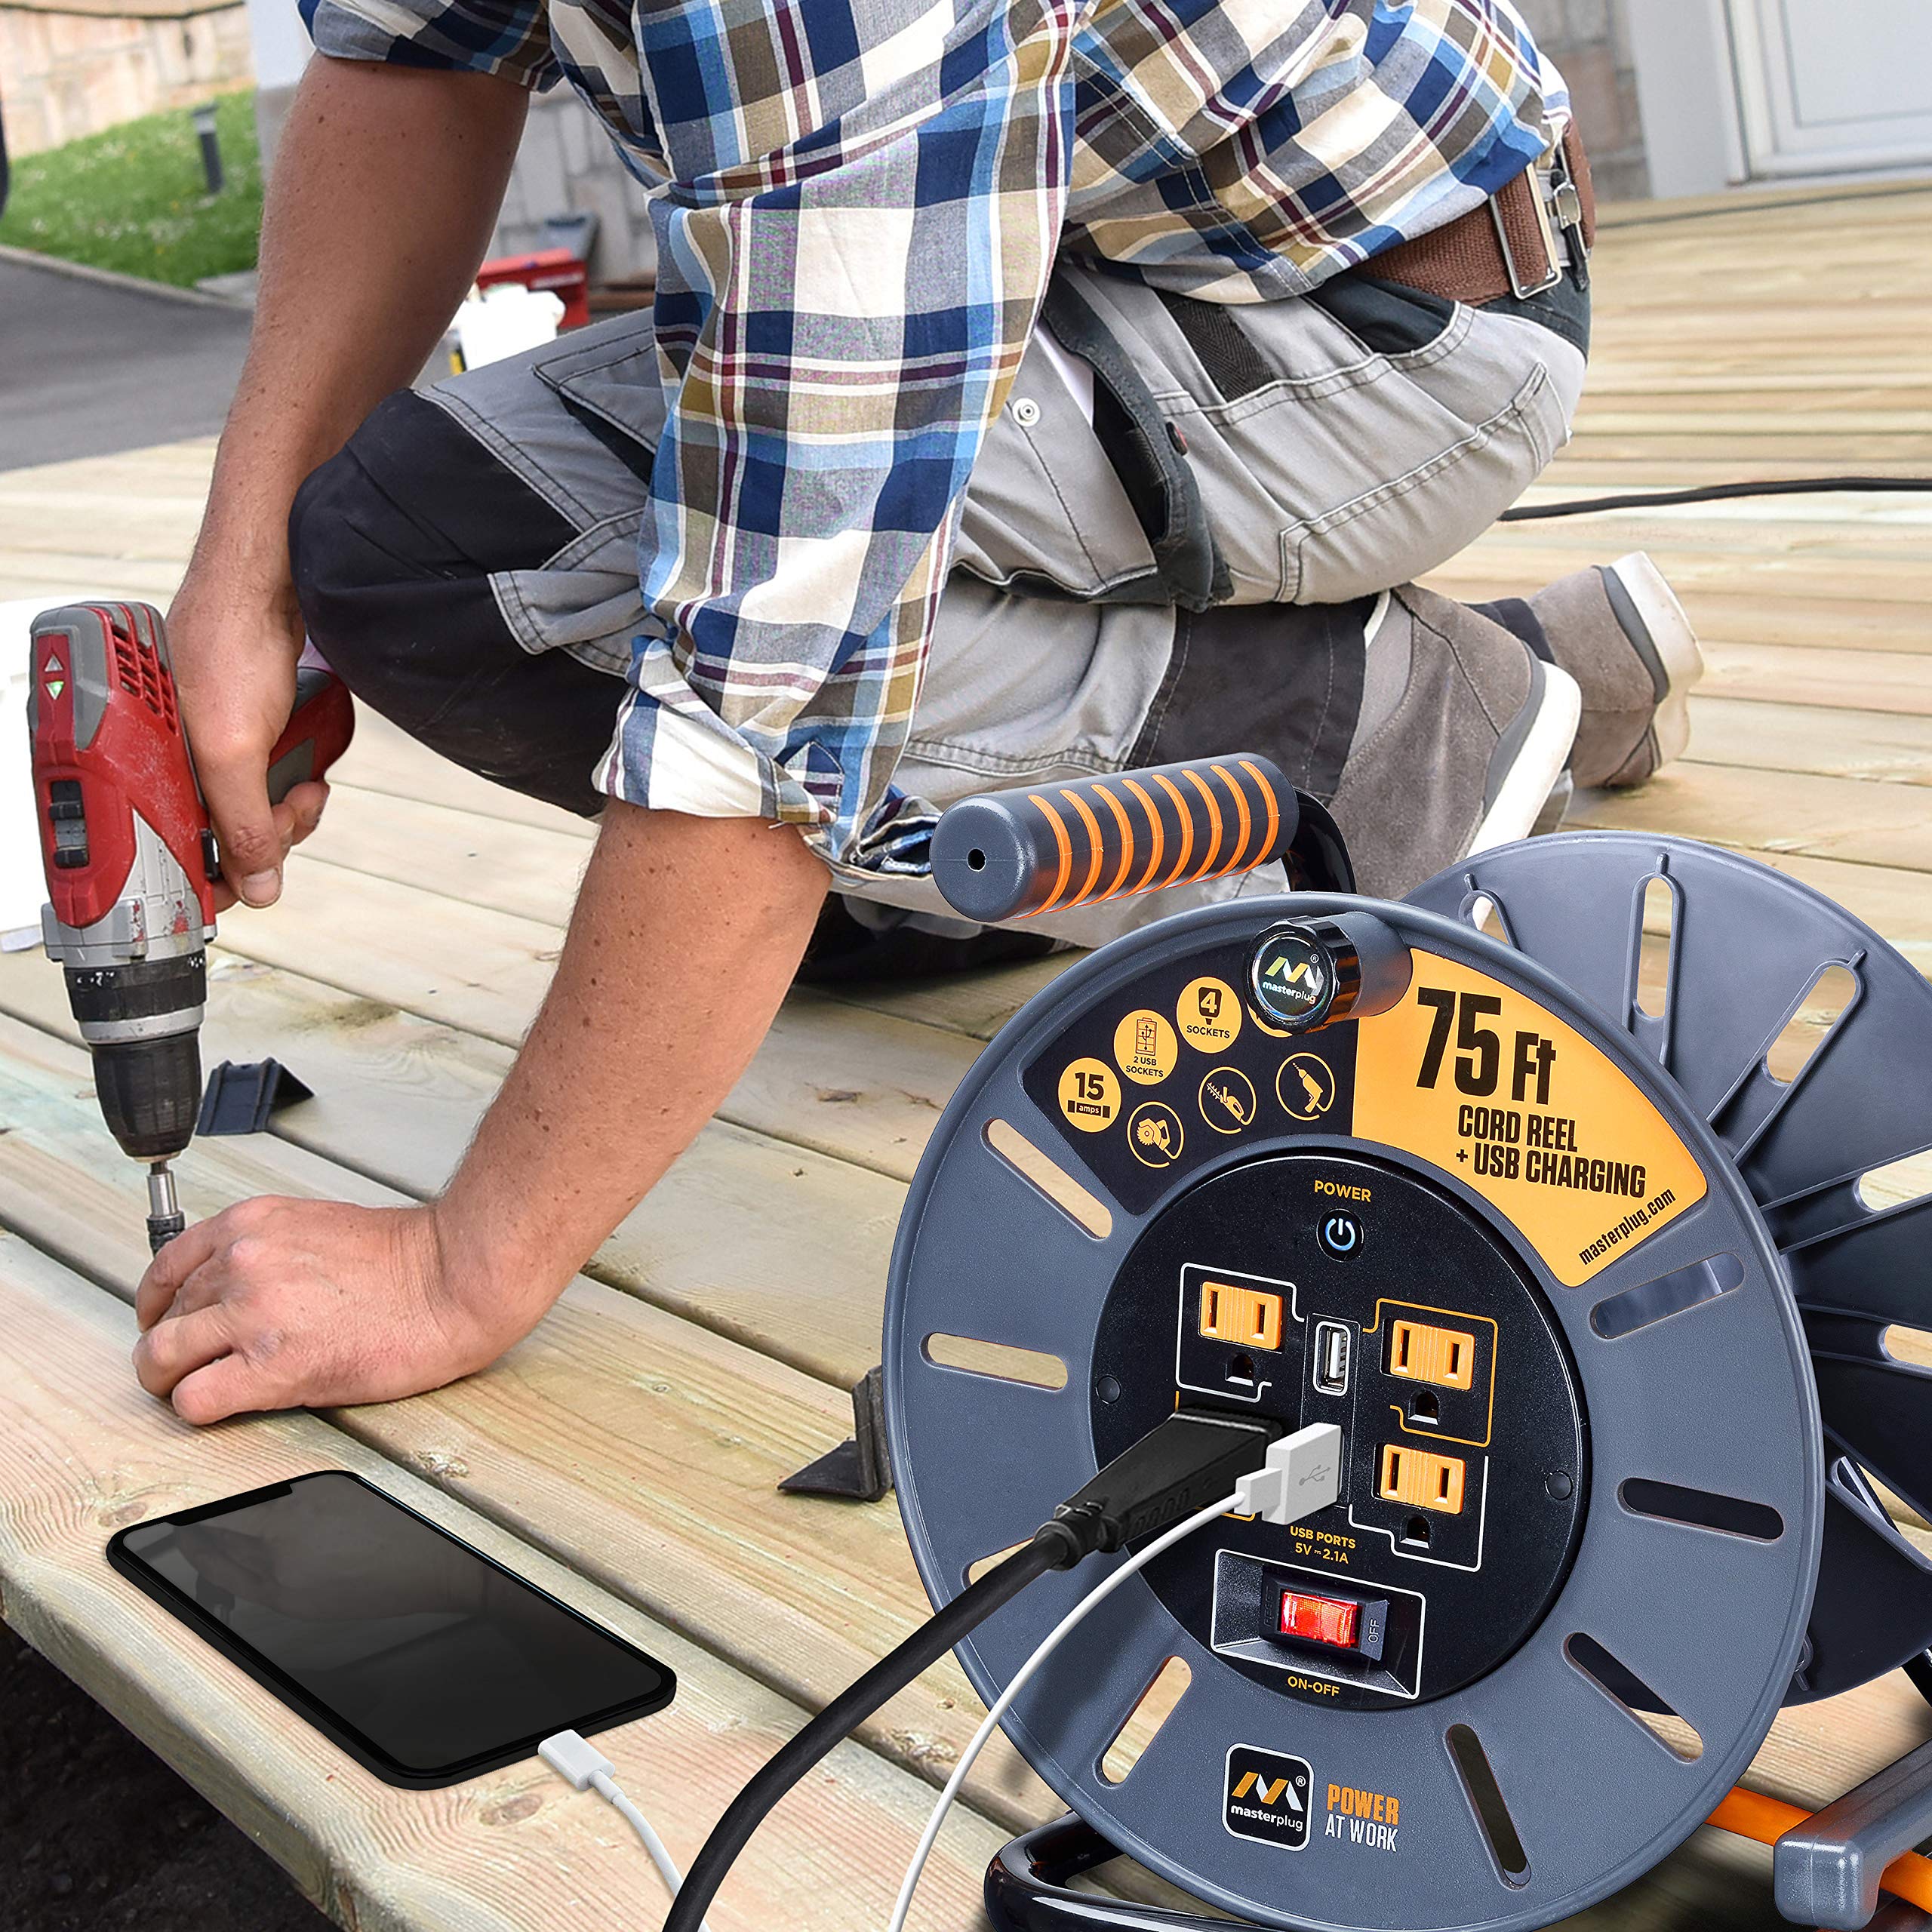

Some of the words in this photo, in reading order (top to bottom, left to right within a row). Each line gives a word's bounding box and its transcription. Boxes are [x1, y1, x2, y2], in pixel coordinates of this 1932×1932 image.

[1201, 991, 1217, 1014] 4
[1262, 981, 1316, 1004] masterplug
[1186, 1024, 1230, 1039] SOCKETS
[1416, 986, 1502, 1097] 75
[1512, 1031, 1556, 1105] Ft
[1125, 1065, 1164, 1078] SOCKETS
[1140, 1057, 1157, 1066] USB
[1075, 1072, 1105, 1100] 15
[1078, 1104, 1100, 1115] amps
[1458, 1104, 1521, 1144] CORD
[1526, 1114, 1578, 1152] REEL
[1474, 1142, 1521, 1180] USB
[1526, 1150, 1646, 1198] CHARGING
[1314, 1180, 1371, 1202] POWER
[1578, 1189, 1676, 1266] masterplug.com
[1290, 1526, 1314, 1540] USB
[1316, 1531, 1356, 1549] PORTS
[1367, 1618, 1379, 1643] OFF
[1287, 1676, 1340, 1697] ON-OFF
[1327, 1783, 1399, 1826] POWER
[1230, 1804, 1303, 1832] masterplug
[1324, 1813, 1346, 1838] AT
[1349, 1818, 1398, 1851] WORK
